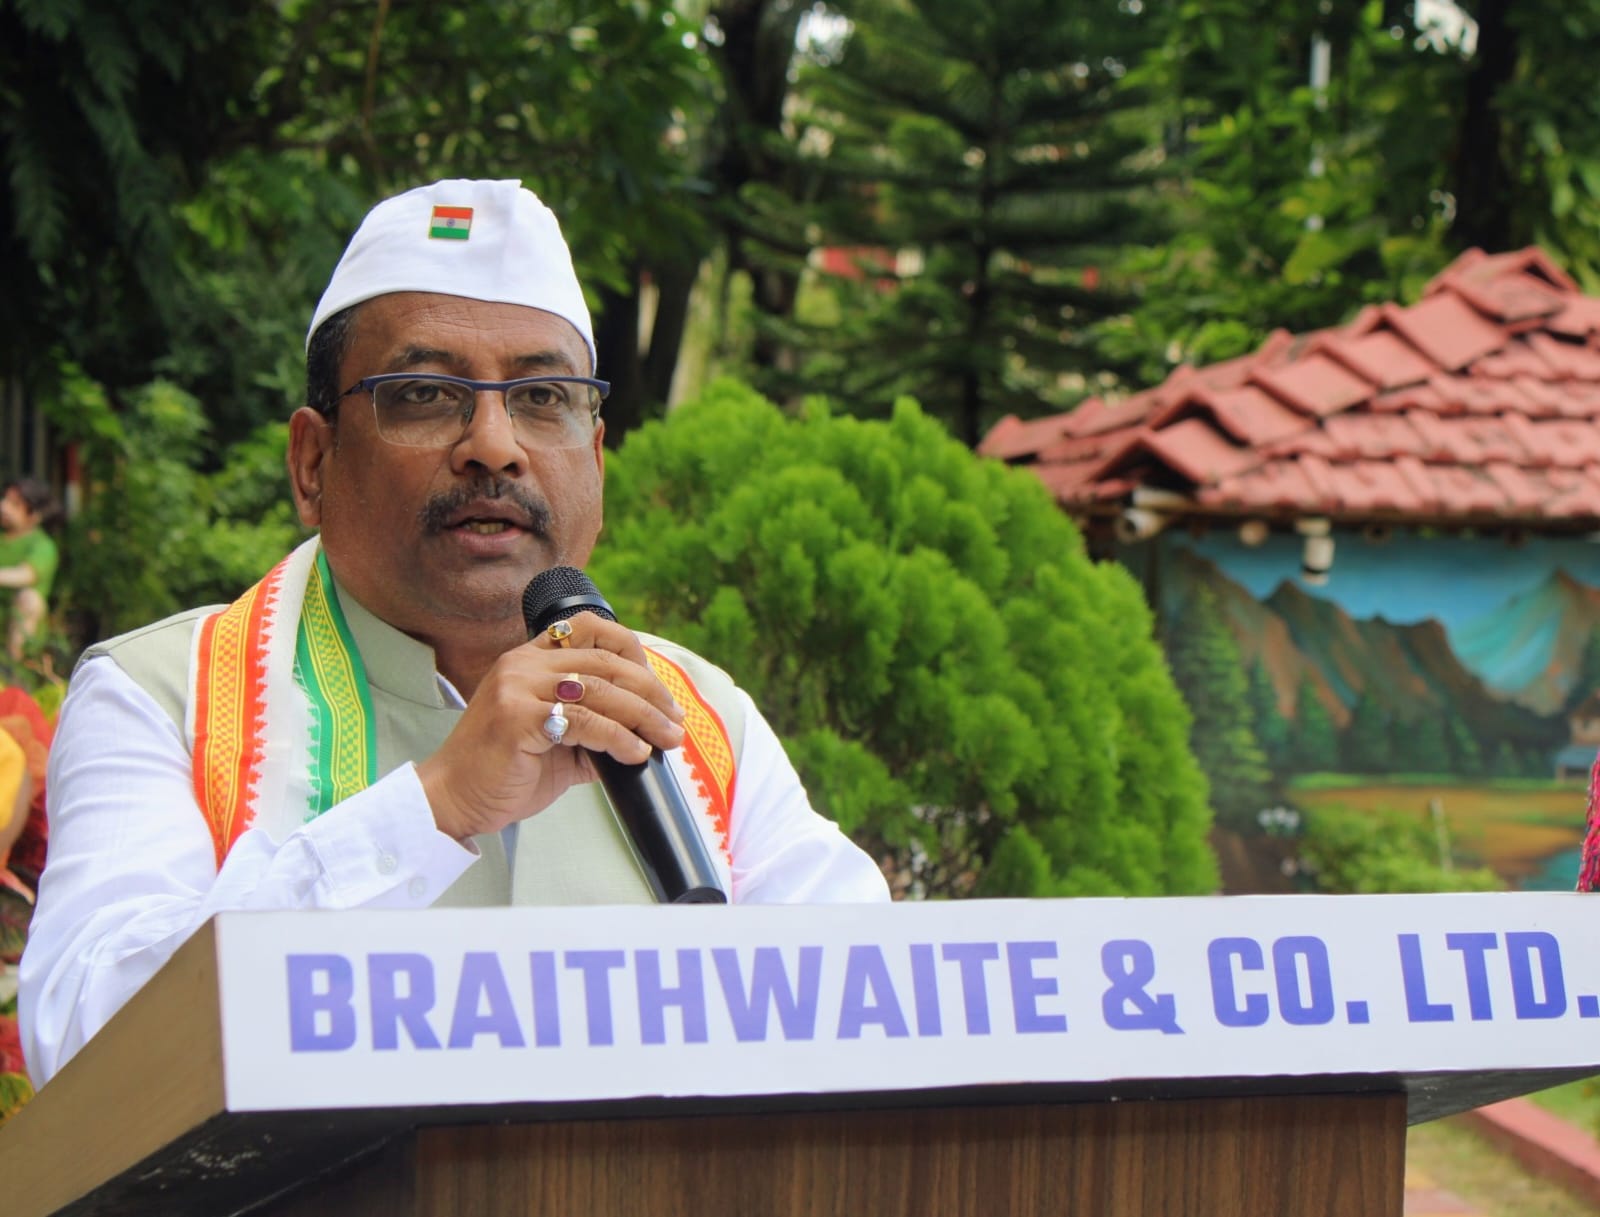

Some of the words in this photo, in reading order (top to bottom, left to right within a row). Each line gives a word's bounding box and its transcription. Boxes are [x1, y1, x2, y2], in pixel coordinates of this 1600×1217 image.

[287, 940, 1069, 1054] BRAITHWAITE
[1101, 939, 1185, 1035] &
[1207, 935, 1371, 1028] CO.
[1397, 930, 1600, 1023] LTD.
